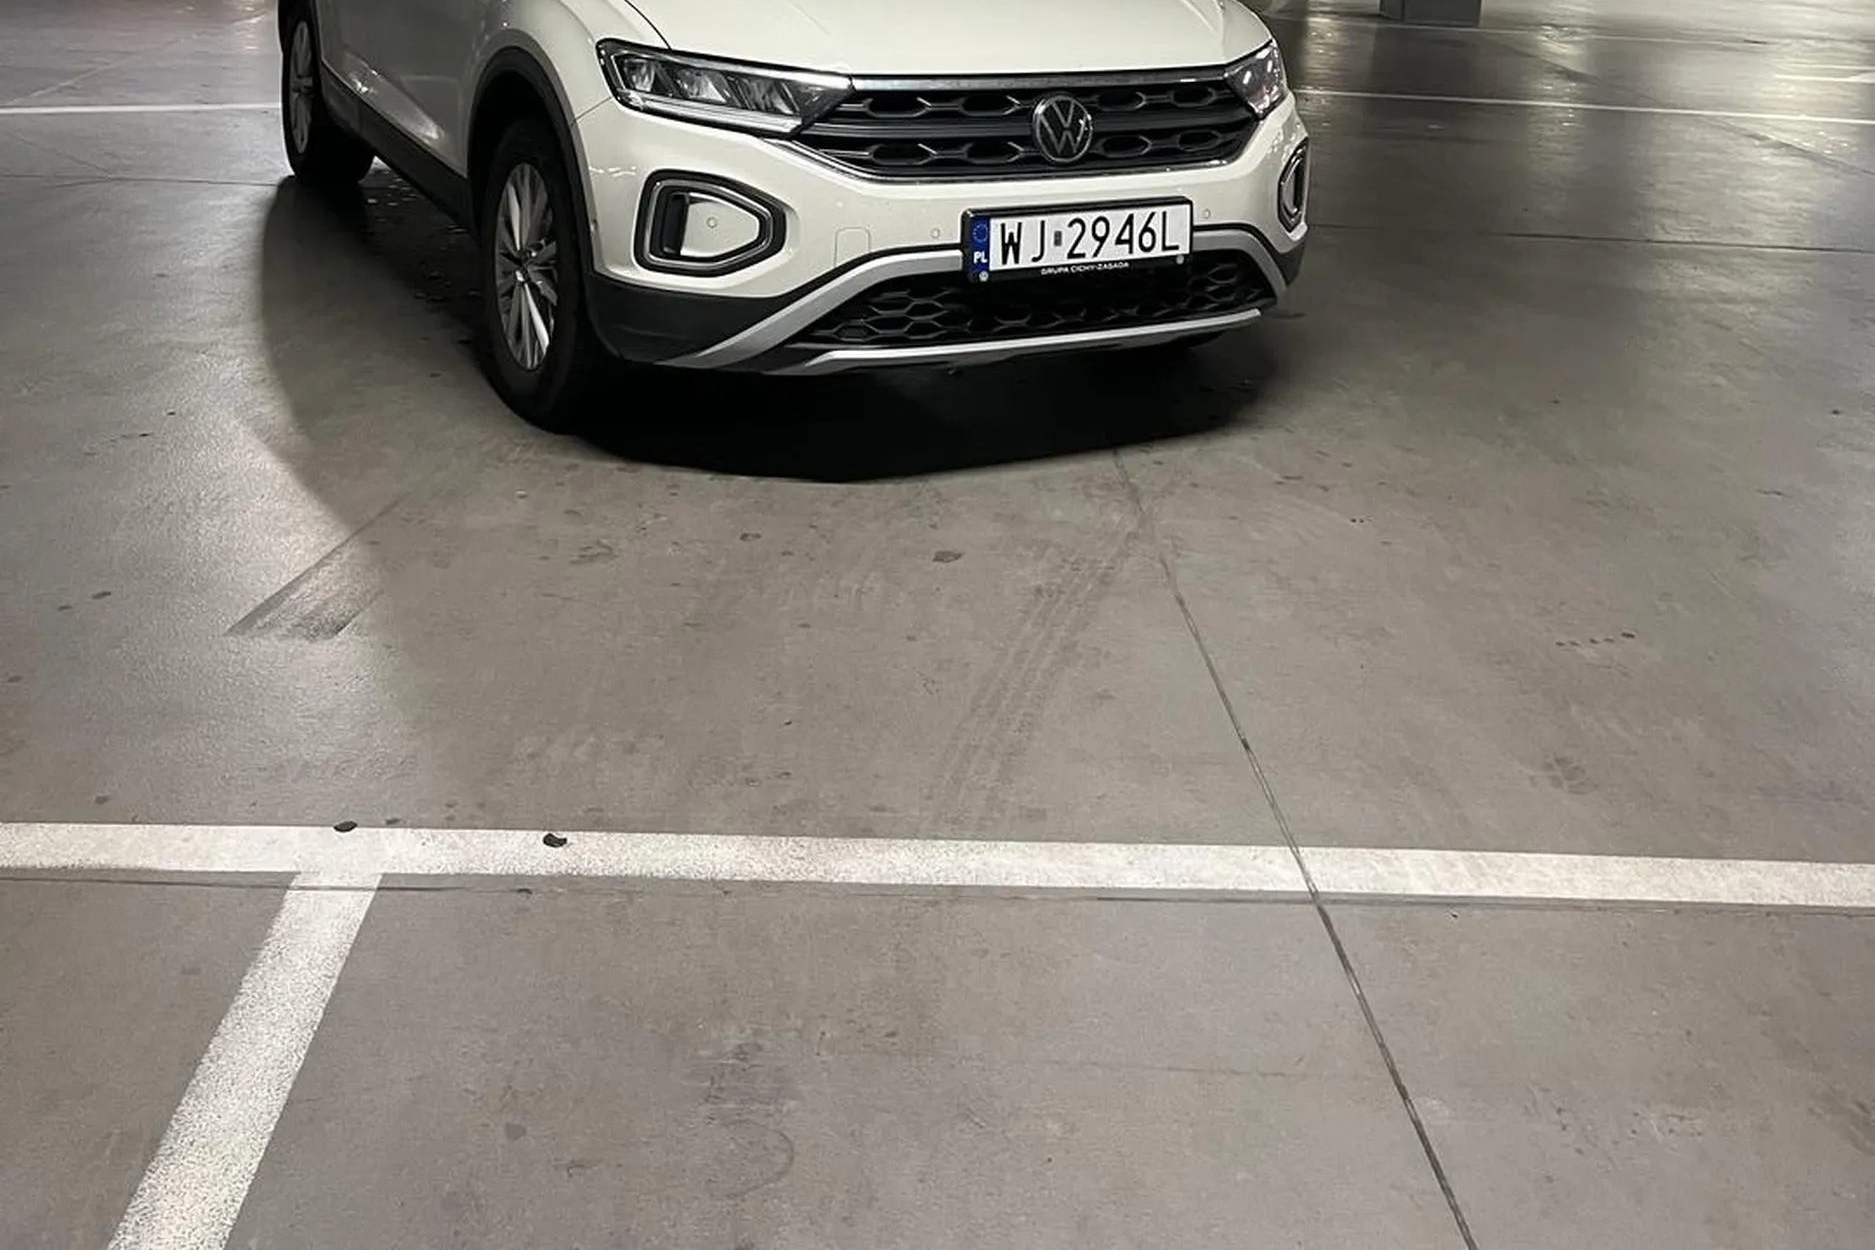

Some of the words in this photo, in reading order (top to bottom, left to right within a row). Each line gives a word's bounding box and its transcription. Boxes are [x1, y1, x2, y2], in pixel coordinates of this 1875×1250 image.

[1001, 219, 1046, 265] WJ
[1067, 210, 1180, 260] 2946L
[973, 251, 988, 264] PL
